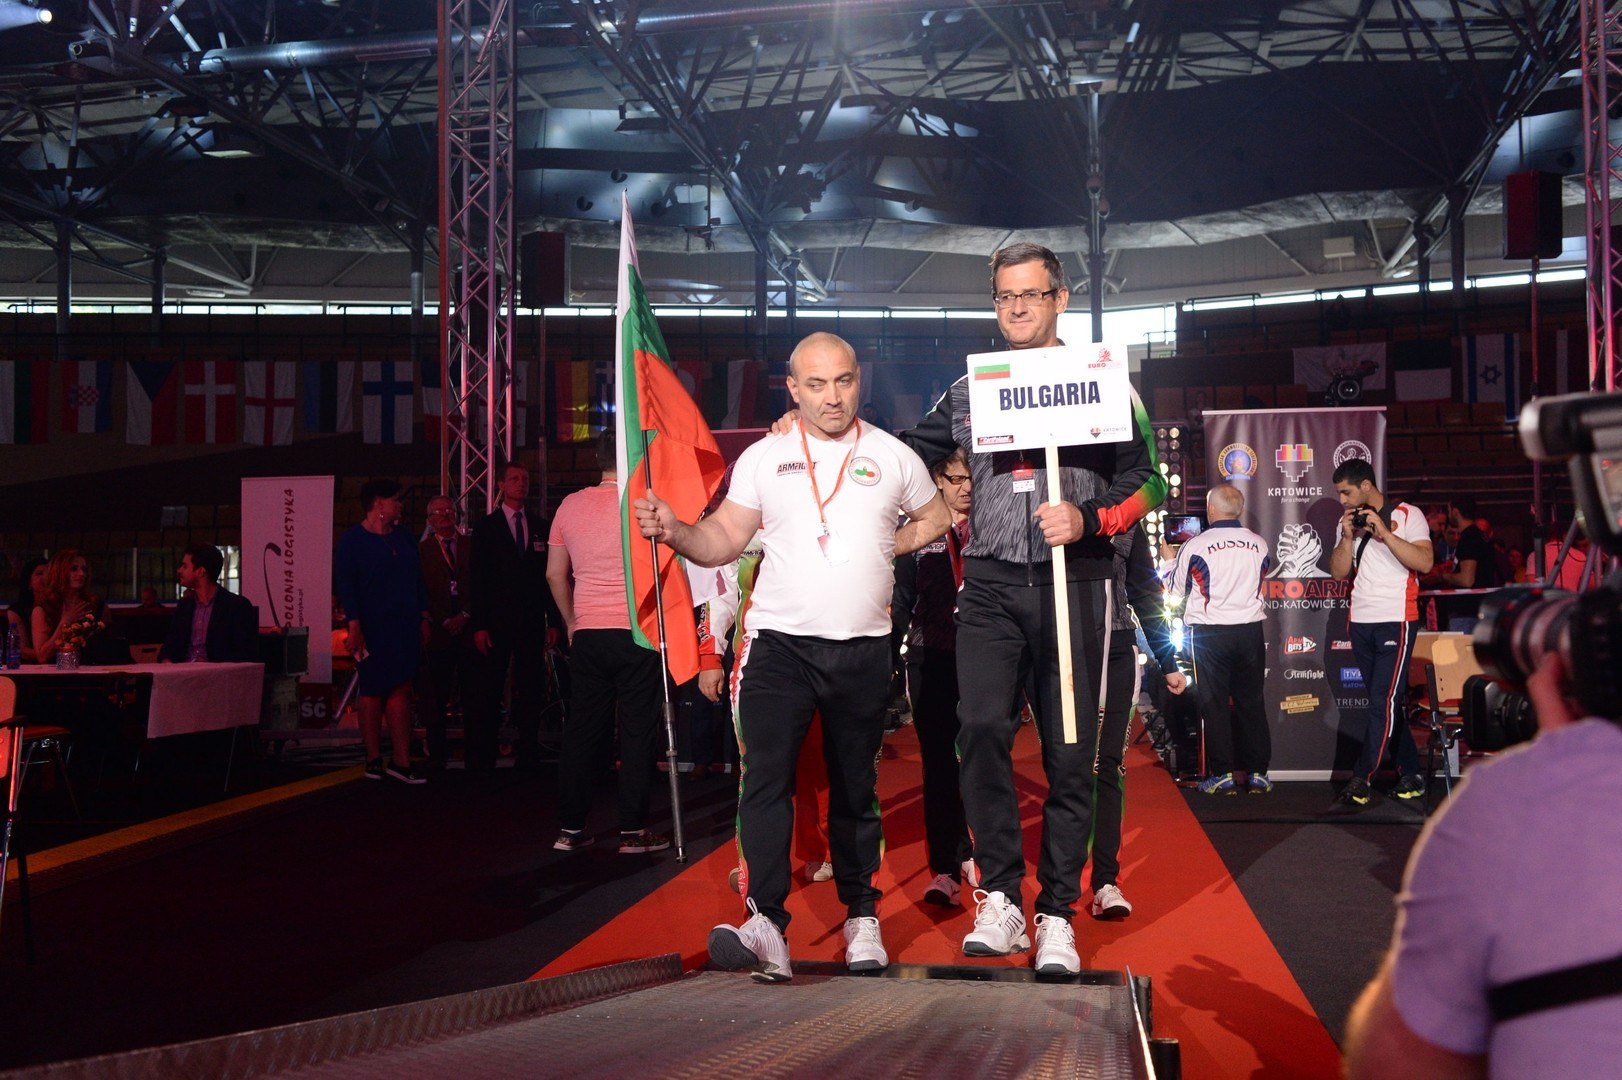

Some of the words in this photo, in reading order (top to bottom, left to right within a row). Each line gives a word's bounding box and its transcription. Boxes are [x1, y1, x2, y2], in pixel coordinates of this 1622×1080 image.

[999, 381, 1101, 411] BULGARIA
[776, 461, 818, 474] ARMFIGT
[1267, 487, 1323, 497] KATOWICE
[283, 488, 295, 566] LOGISTYKA
[1263, 600, 1336, 609] ND-KATOWICE
[301, 696, 326, 718] ŚĆ
[1337, 698, 1369, 706] TREND
